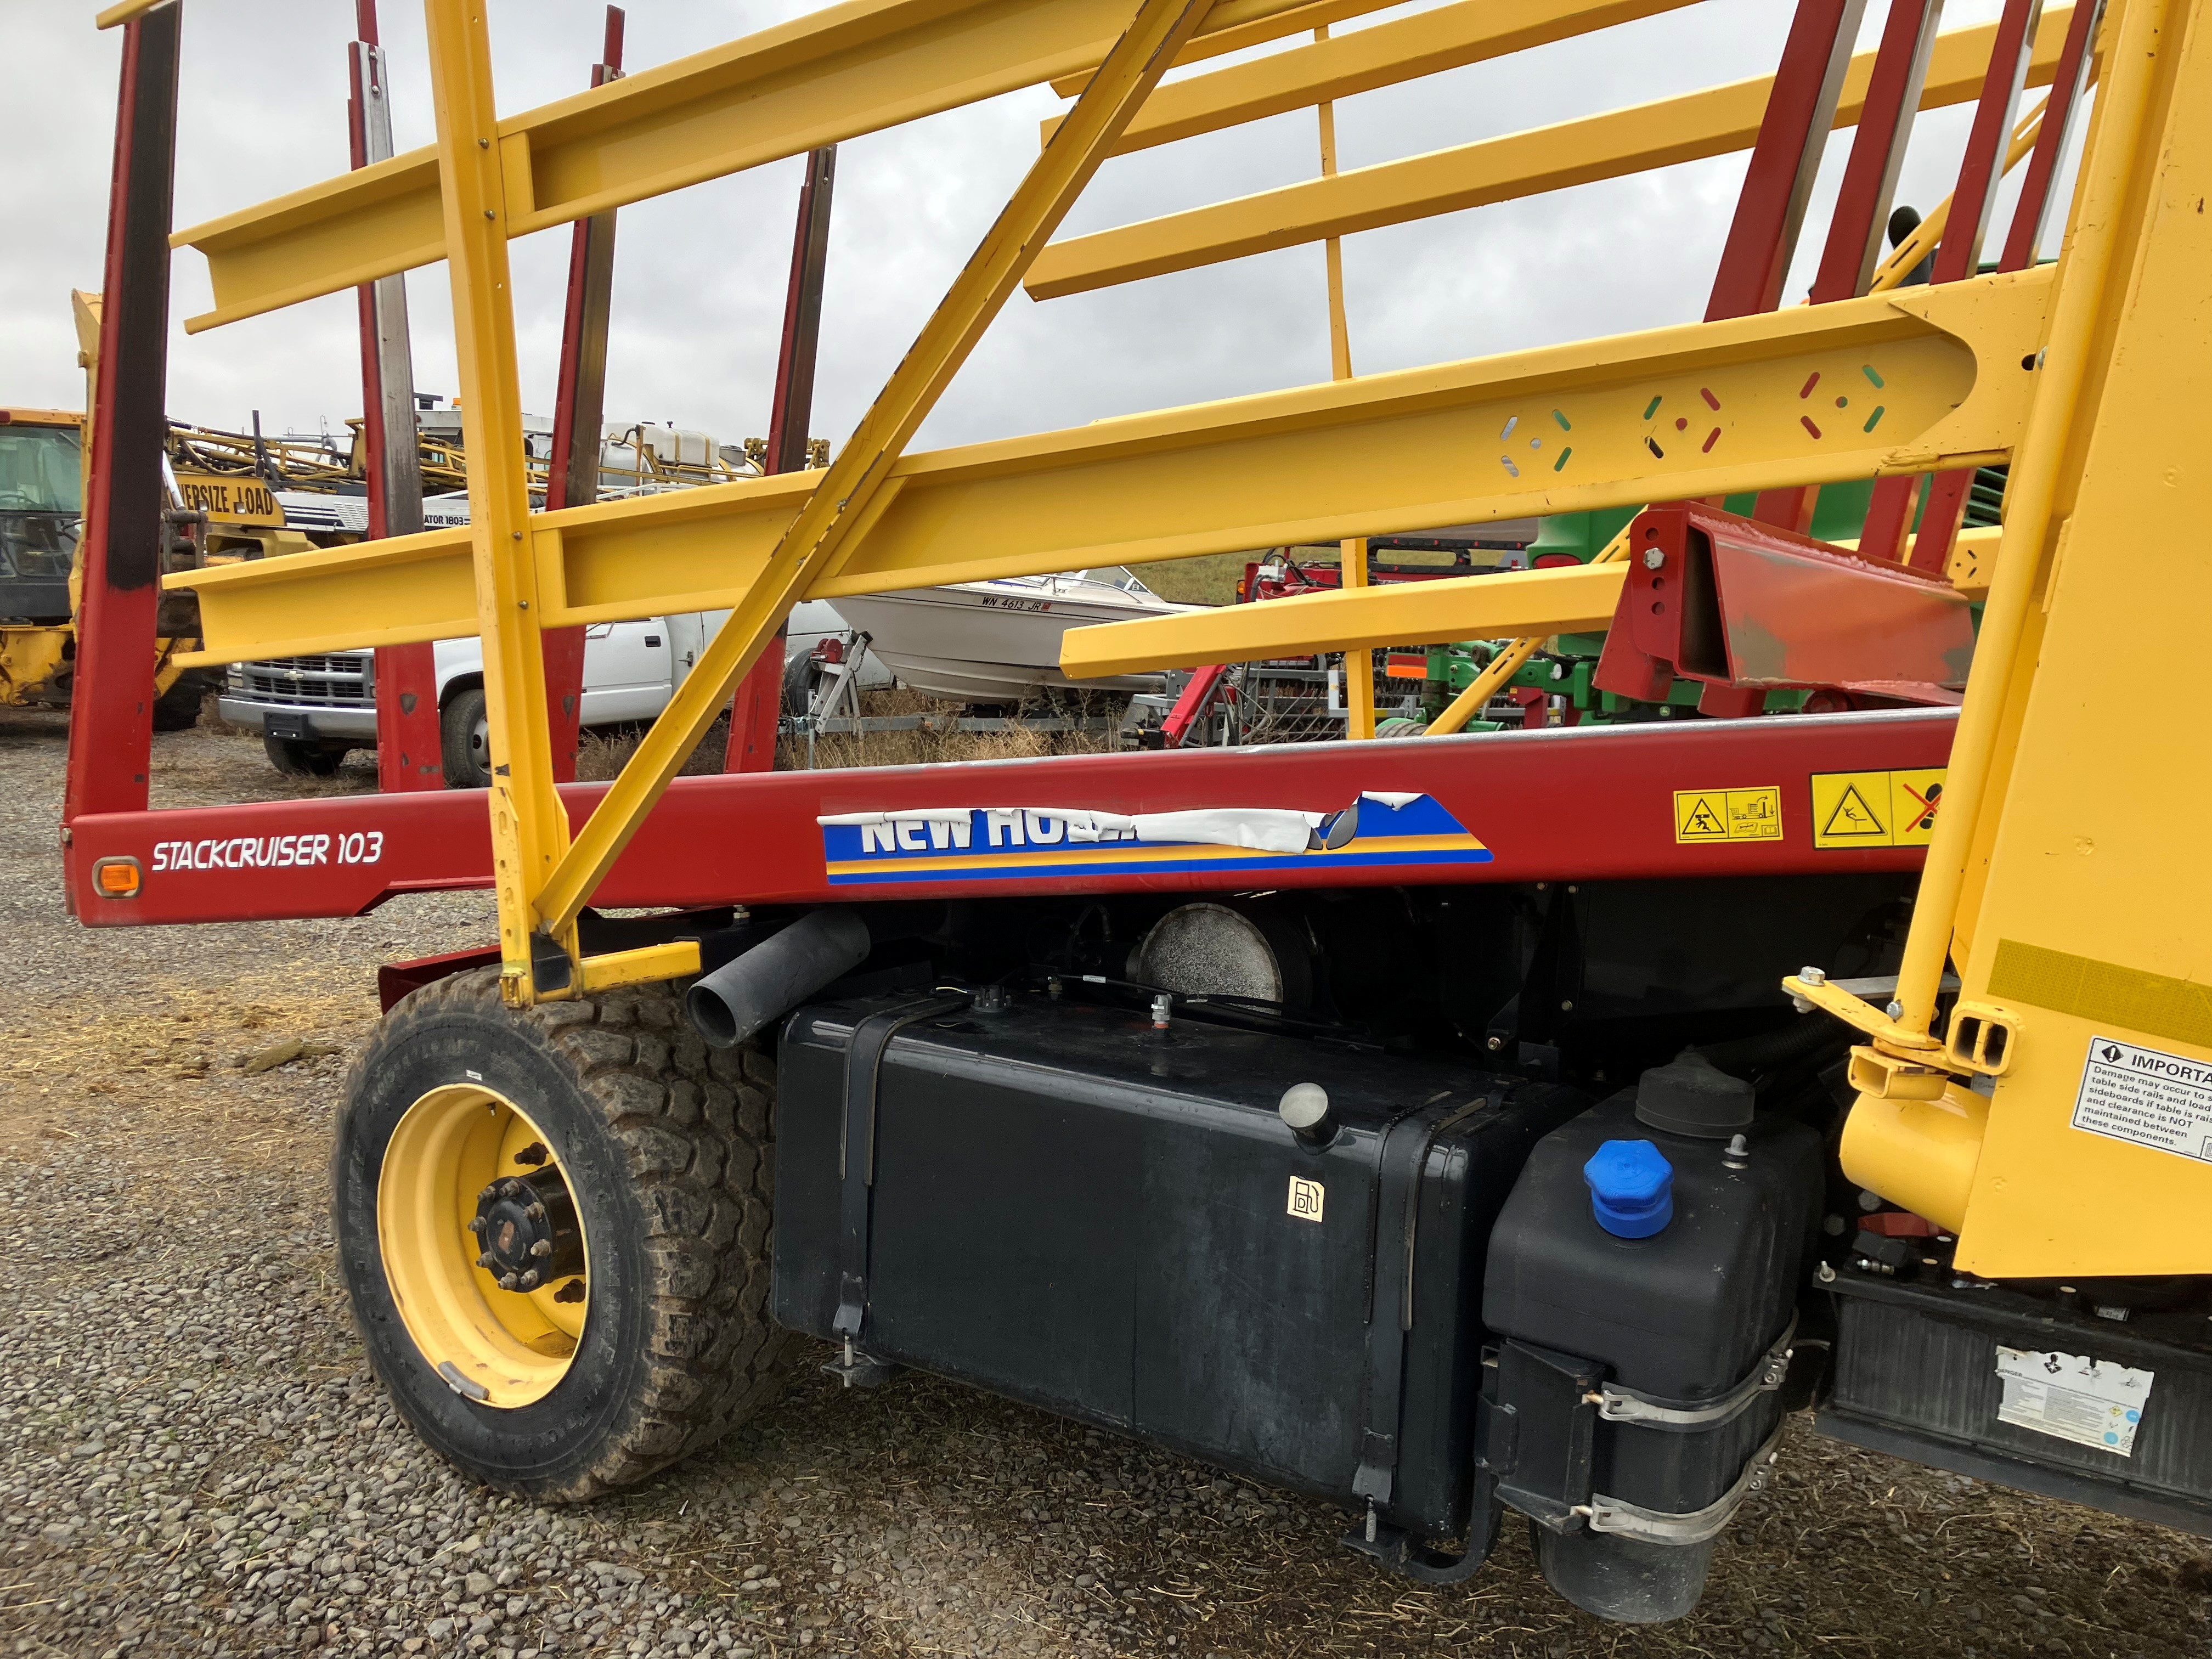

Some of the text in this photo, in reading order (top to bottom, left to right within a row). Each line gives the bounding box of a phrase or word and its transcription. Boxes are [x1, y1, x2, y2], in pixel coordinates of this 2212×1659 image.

[177, 483, 273, 516] VERSIZE LOAD
[424, 515, 464, 526] ATOR 1803
[982, 596, 1041, 611] WN 4613 JR
[152, 831, 384, 871] STACKCRUISER 103
[861, 819, 972, 854] NEW
[2094, 1066, 2135, 1082] Damage
[2138, 1078, 2161, 1090] may
[2163, 1085, 2192, 1096] occur
[2194, 1091, 2204, 1099] to
[2132, 1054, 2212, 1085] IMPORTA
[2089, 1086, 2212, 1124] sideboards if table is rais
[2092, 1076, 2211, 1111] table side rails and load
[2084, 1107, 2188, 1138] maintained between
[2086, 1097, 2194, 1128] and clearance is NOT
[2081, 1115, 2177, 1146] these components.
[1297, 1197, 1306, 1209] D
